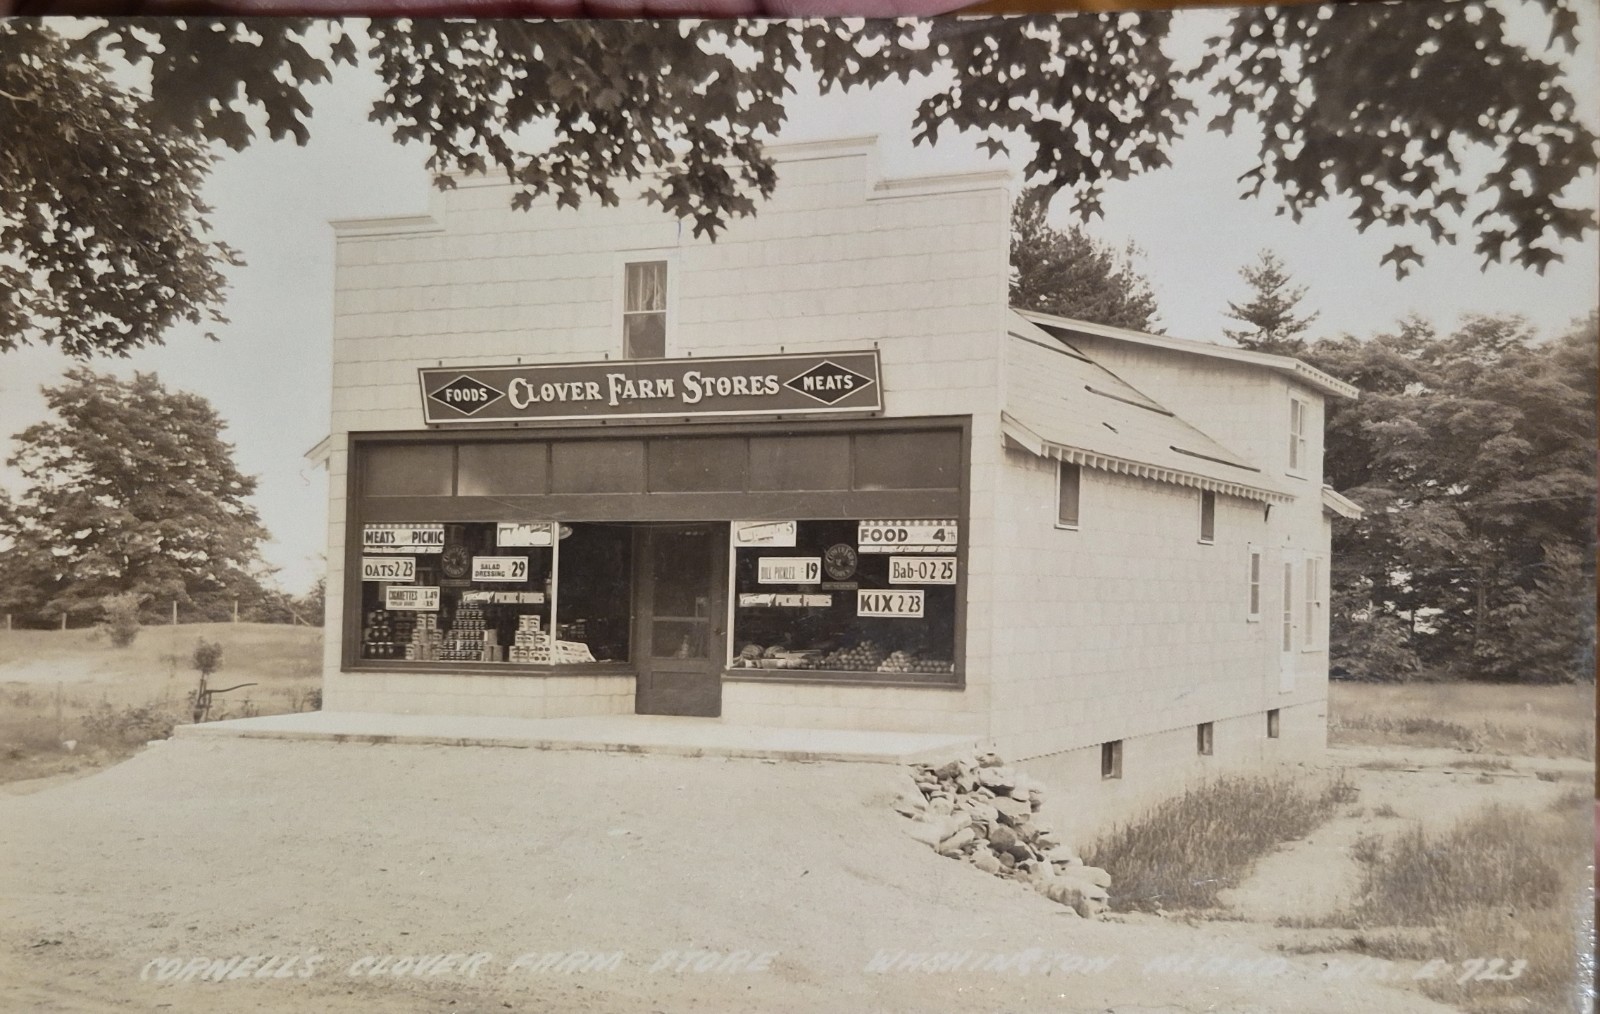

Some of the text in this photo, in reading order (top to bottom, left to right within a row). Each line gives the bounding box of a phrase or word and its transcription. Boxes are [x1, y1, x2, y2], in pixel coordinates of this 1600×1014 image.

[507, 371, 780, 410] CLOVER FARM STORES
[802, 374, 854, 391] MEATS
[445, 387, 488, 402] FOODS
[365, 531, 444, 544] MEATS PICNIC
[860, 528, 908, 542] FOOD
[364, 563, 394, 577] OATS
[511, 561, 526, 577] 29
[805, 562, 818, 580] 19
[892, 561, 927, 579] Bab-O
[860, 594, 893, 612] KIX
[897, 595, 904, 612] 2
